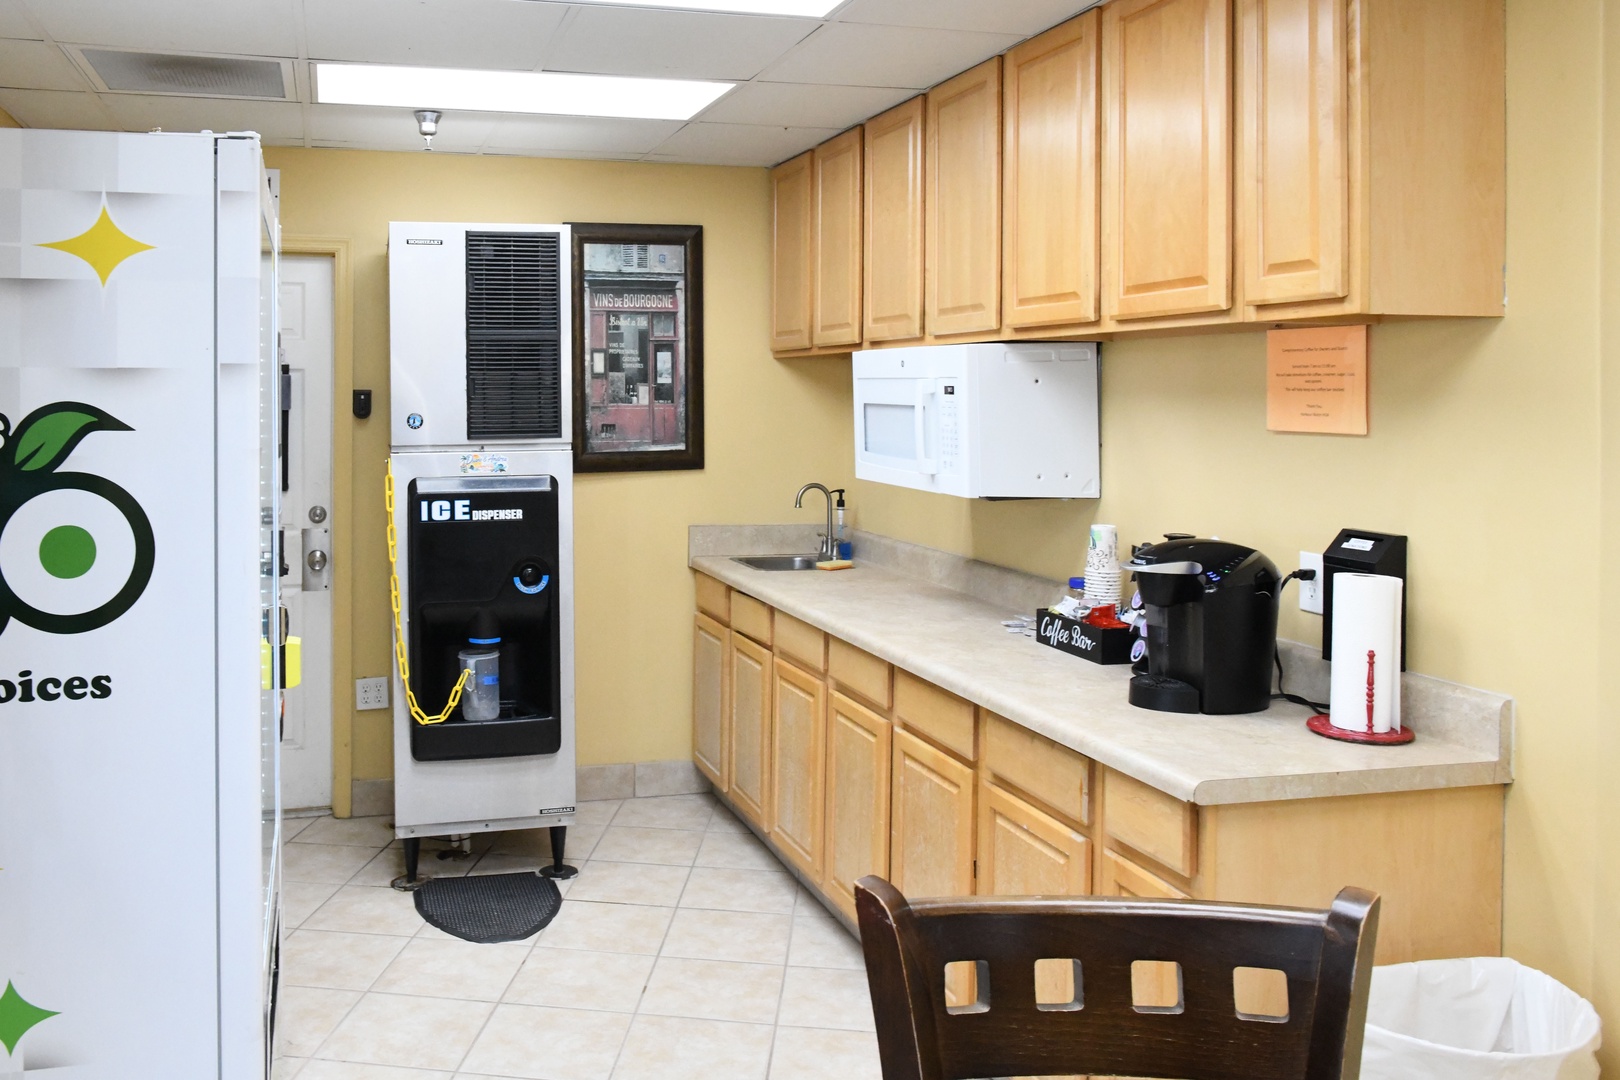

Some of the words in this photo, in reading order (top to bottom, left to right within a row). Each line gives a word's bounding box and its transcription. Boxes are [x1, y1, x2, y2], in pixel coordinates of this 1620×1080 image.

[593, 293, 613, 308] VINS
[614, 297, 624, 308] DE
[624, 293, 673, 308] BOURGOGNE
[420, 499, 471, 522] ICE
[472, 509, 523, 521] DISPENSER
[1041, 616, 1070, 646] Coffee
[1071, 625, 1096, 650] Bar
